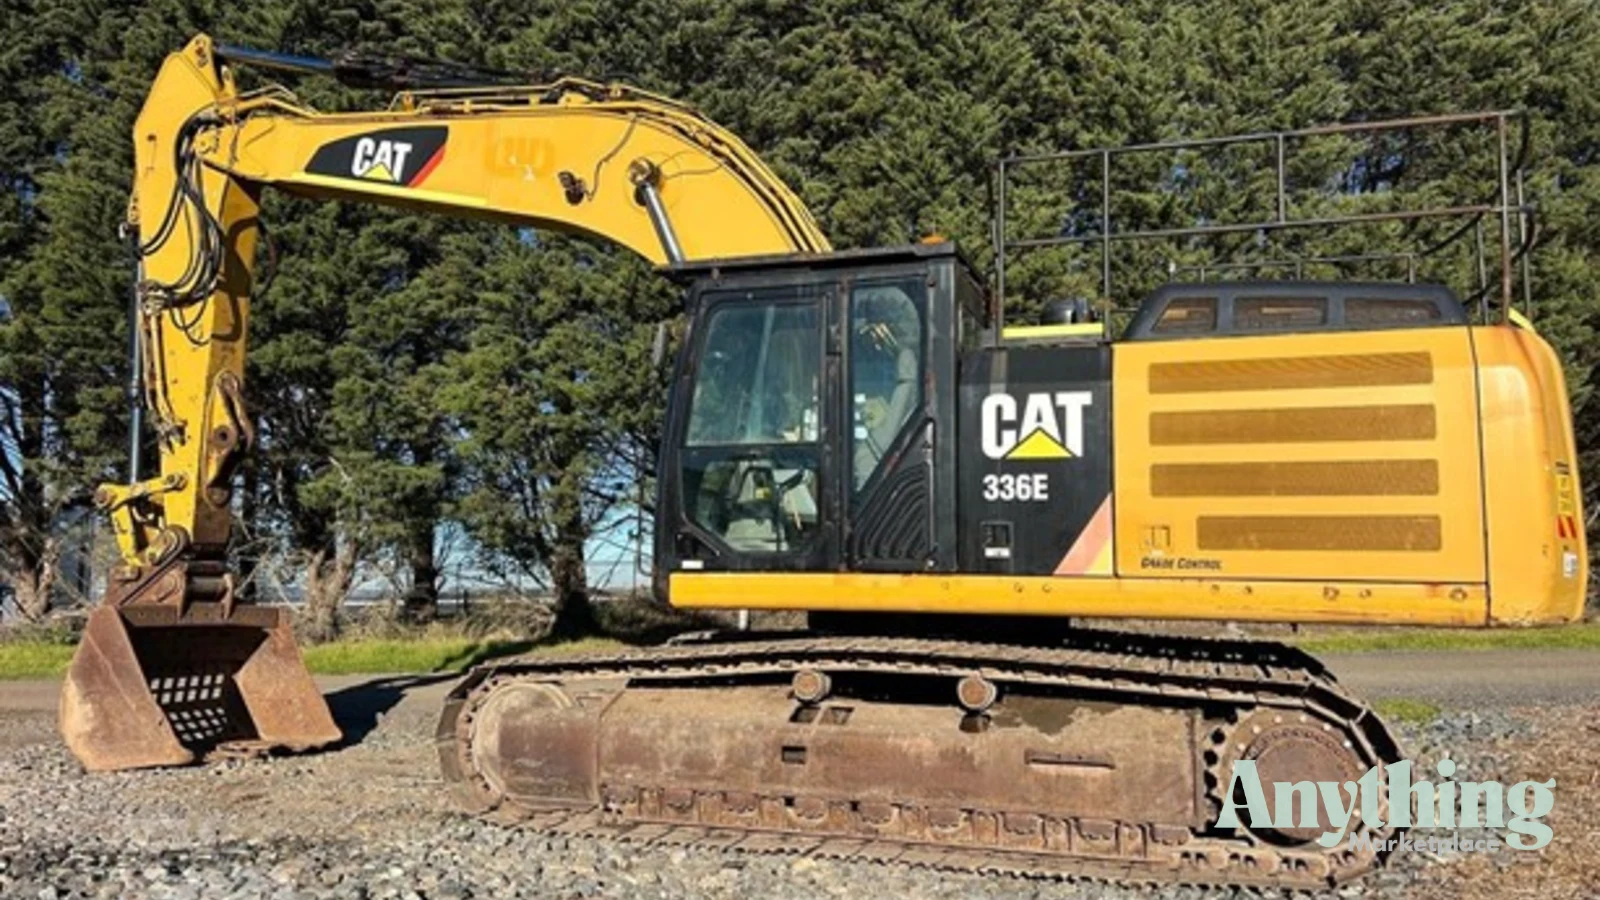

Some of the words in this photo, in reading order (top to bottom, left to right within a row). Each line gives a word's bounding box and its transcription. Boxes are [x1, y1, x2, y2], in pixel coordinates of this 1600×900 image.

[352, 137, 412, 182] CAT
[982, 391, 1092, 459] CAT
[983, 474, 1048, 501] 336E
